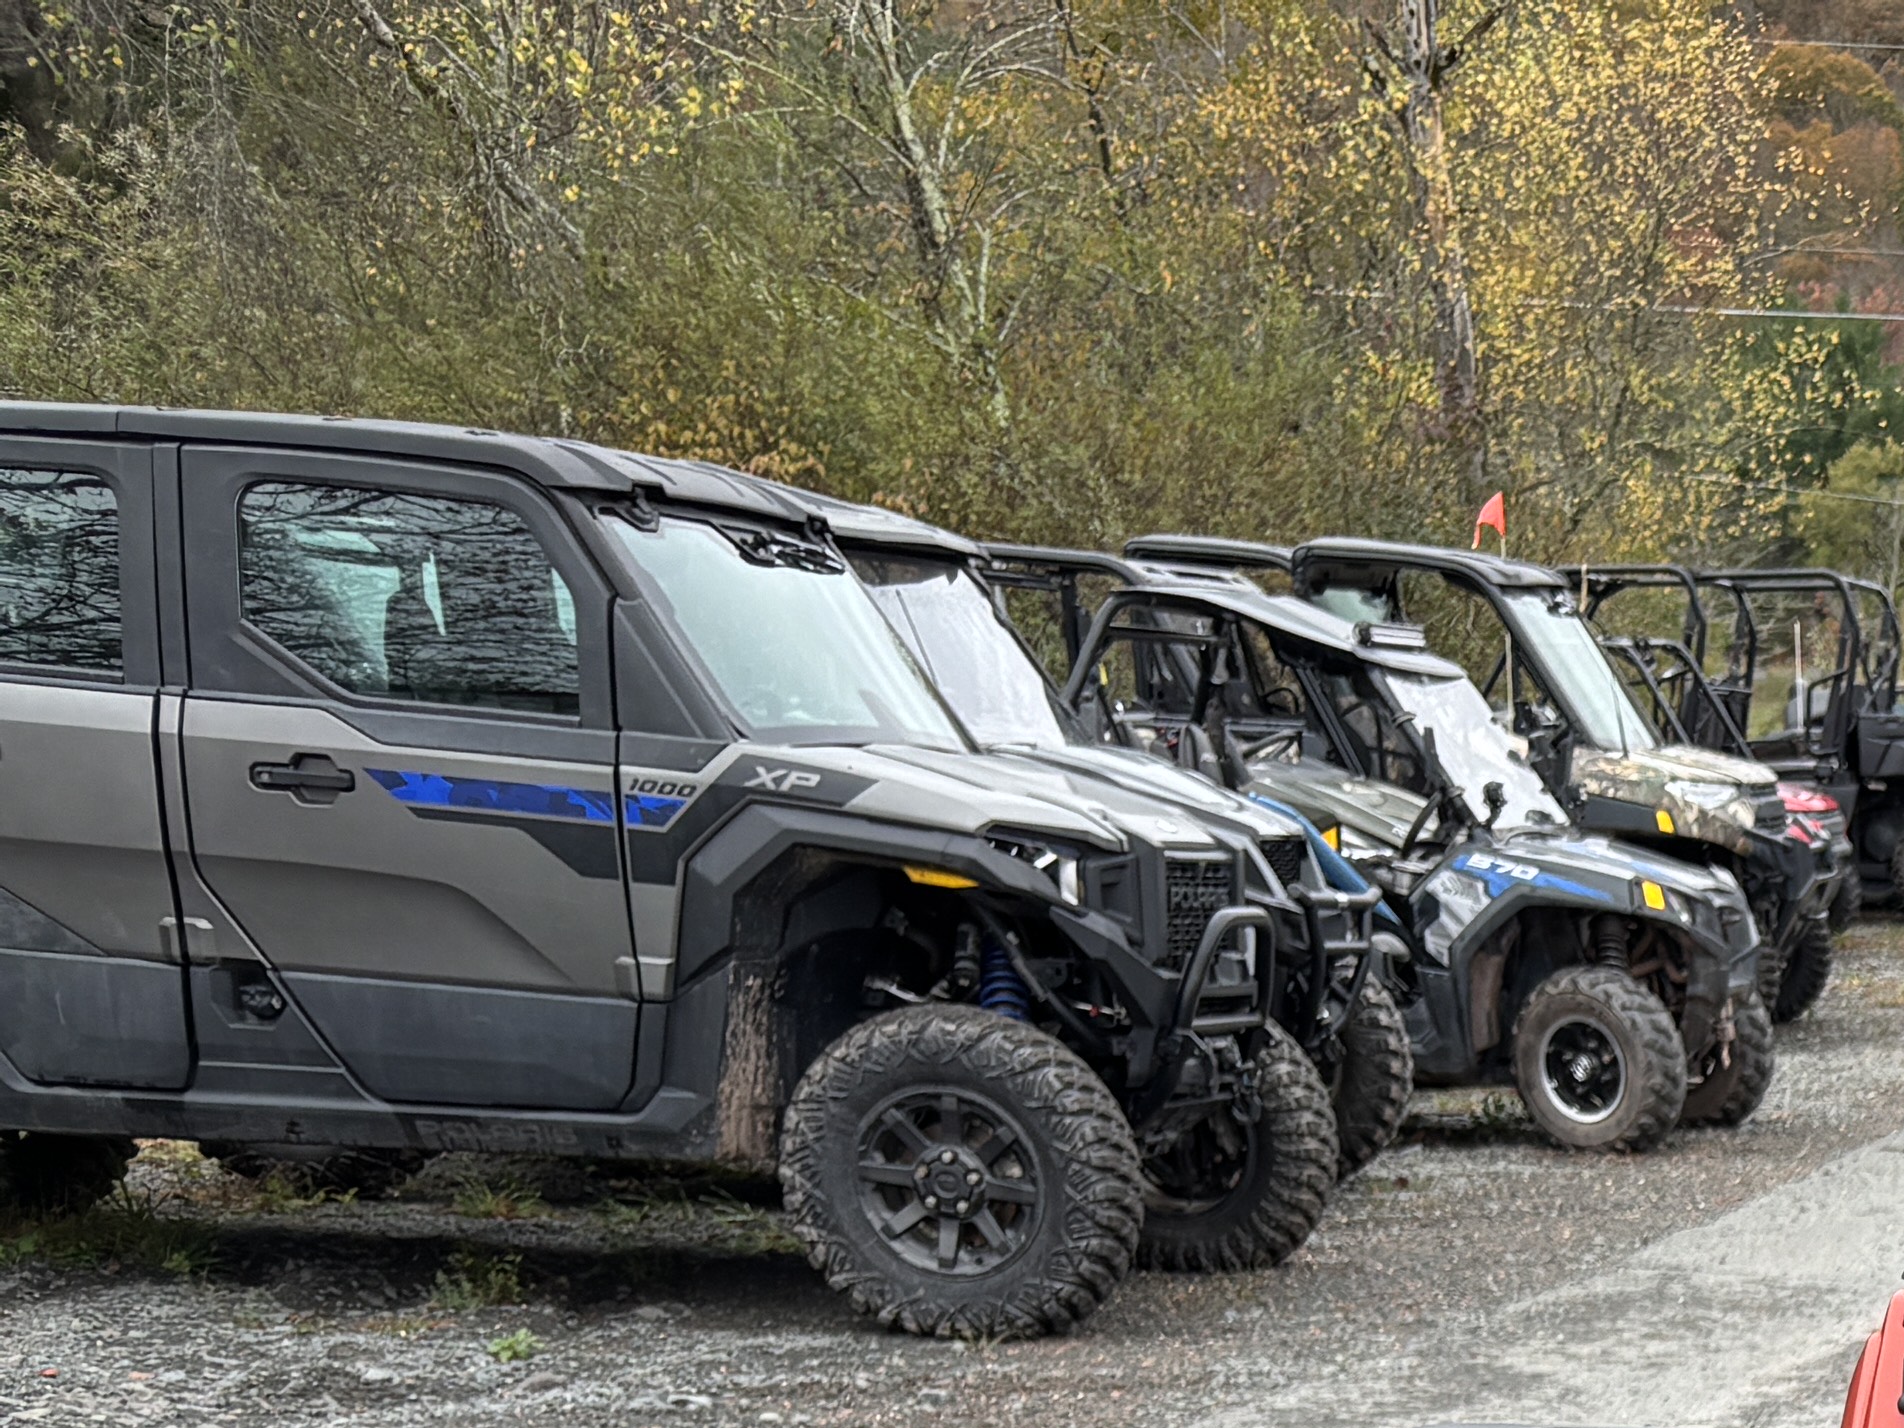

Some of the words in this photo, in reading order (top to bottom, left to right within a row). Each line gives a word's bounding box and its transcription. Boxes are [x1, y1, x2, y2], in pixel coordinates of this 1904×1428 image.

[629, 778, 697, 798] 1000
[743, 766, 821, 792] XP
[1466, 853, 1540, 881] 570
